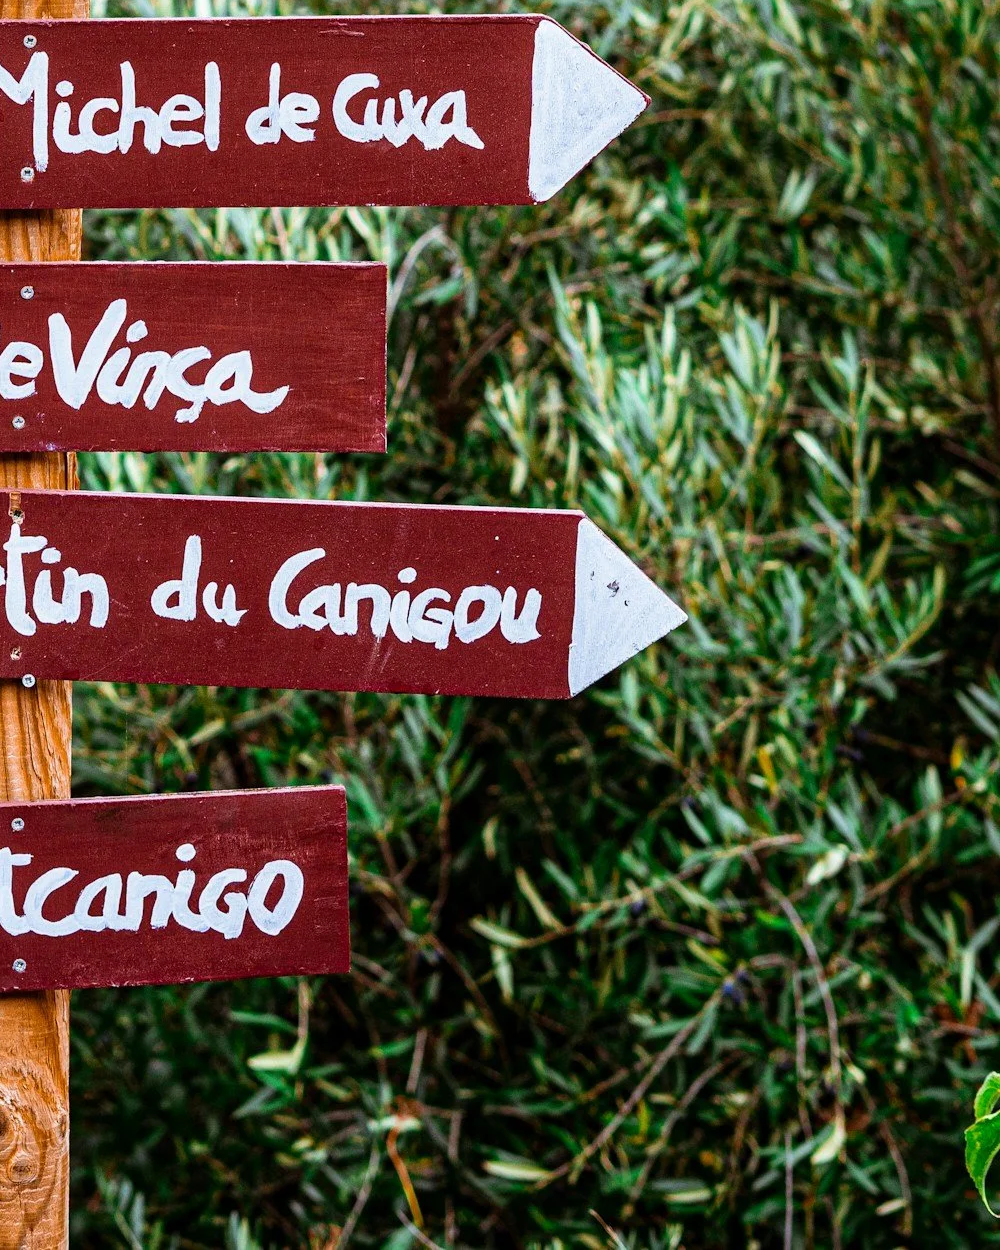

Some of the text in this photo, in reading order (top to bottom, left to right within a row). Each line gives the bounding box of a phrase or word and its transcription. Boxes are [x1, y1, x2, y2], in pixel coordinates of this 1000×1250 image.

[245, 62, 321, 146] de
[332, 72, 485, 151] Cuxa
[48, 298, 290, 424] Vinça
[150, 534, 248, 627] du
[268, 547, 543, 650] Canigou
